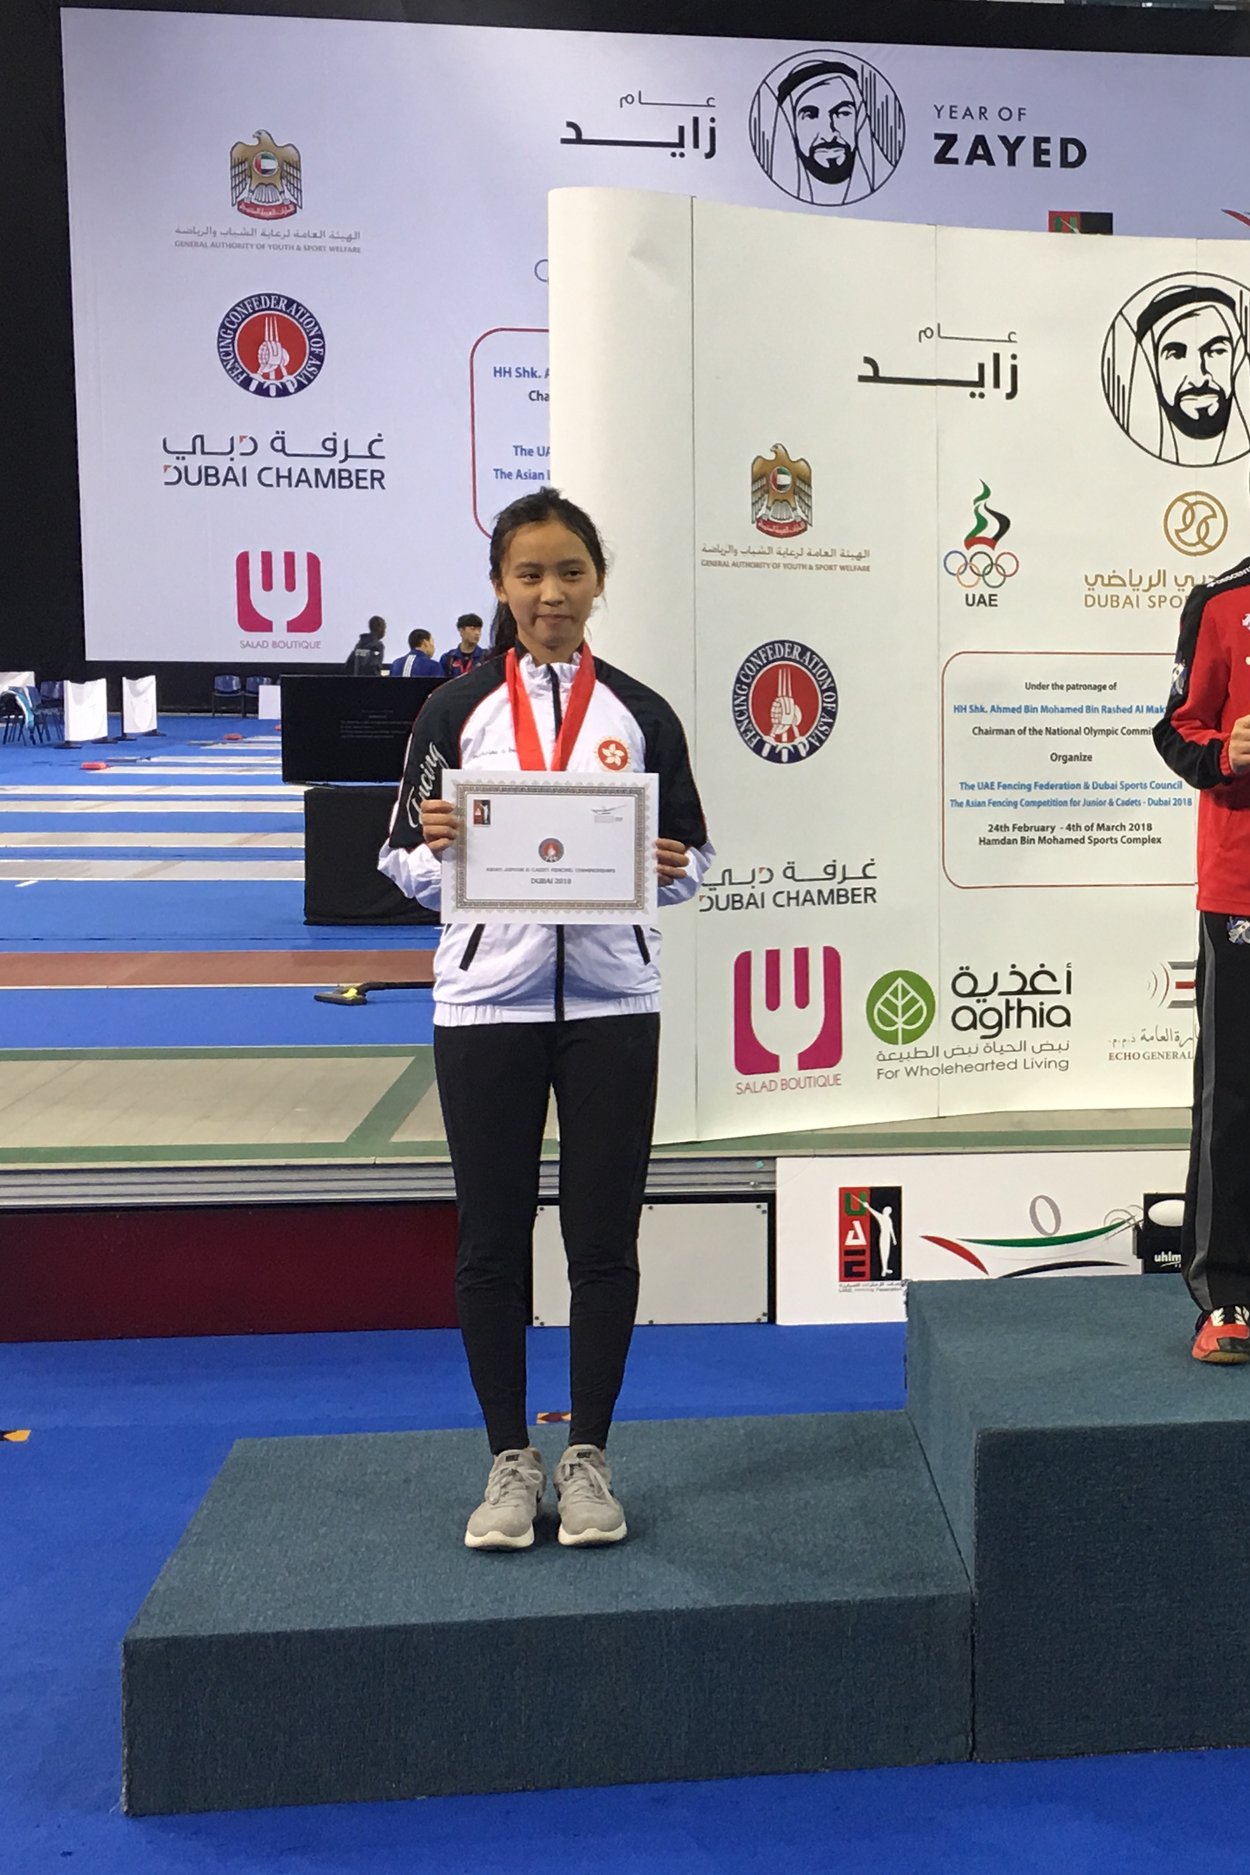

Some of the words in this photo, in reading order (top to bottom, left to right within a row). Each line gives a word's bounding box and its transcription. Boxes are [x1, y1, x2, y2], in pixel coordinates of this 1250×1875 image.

[620, 90, 717, 109] عام
[933, 104, 989, 121] YEAR
[998, 106, 1027, 122] OF
[560, 116, 717, 160] زايد
[933, 132, 1088, 169] ZAYED
[224, 295, 321, 337] CONFEDERATION
[918, 322, 1018, 343] عام
[219, 328, 248, 382] FENCING
[309, 338, 324, 356] OF
[296, 355, 321, 385] ASIA
[493, 366, 512, 378] HH
[515, 366, 542, 379] Shk.
[858, 352, 1018, 401] زايد
[162, 434, 258, 462] دبي
[270, 430, 386, 464] غرفة
[513, 445, 534, 457] The
[163, 464, 247, 487] DUBAI
[257, 466, 386, 490] CHAMBER
[493, 468, 513, 480] The
[516, 468, 545, 480] Asian
[772, 561, 781, 570] OF
[1084, 568, 1167, 593] الرياضي
[964, 593, 998, 608] UAE
[1084, 594, 1140, 609] DUBAI
[1147, 594, 1189, 609] SPO
[240, 640, 269, 649] SALAD
[271, 640, 321, 650] BOUTIQUE
[739, 642, 836, 690] CONFEDERATION
[1025, 682, 1050, 691] Under
[1051, 682, 1064, 691] the
[1066, 683, 1107, 692] patronage
[1109, 682, 1117, 691] of
[822, 691, 837, 712] OF
[953, 705, 967, 714] HH
[969, 705, 988, 714] Shk.
[990, 705, 1022, 714] Ahmed
[1023, 705, 1038, 714] Bin
[1040, 705, 1084, 714] Mohamed
[1085, 705, 1099, 714] Bin
[1101, 705, 1133, 714] Rashed
[1134, 705, 1144, 714] Al
[1146, 705, 1166, 714] Mak
[734, 683, 760, 748] FENCING
[808, 713, 834, 747] ASIA
[972, 726, 1016, 736] Chairman
[1017, 726, 1027, 736] of
[1028, 726, 1043, 736] the
[1044, 726, 1082, 736] National
[1083, 726, 1119, 738] Olympic
[1120, 726, 1153, 736] Commi
[1050, 752, 1093, 764] Organize
[959, 781, 975, 791] The
[977, 781, 995, 791] UAE
[997, 781, 1032, 792] Fencing
[1033, 781, 1081, 791] Federation
[1083, 782, 1090, 790] &
[1091, 781, 1118, 790] Dubai
[1119, 781, 1148, 791] Sports
[1149, 781, 1183, 790] Council
[950, 799, 964, 808] The
[965, 799, 986, 808] Asian
[987, 799, 1018, 809] Fencing
[1019, 799, 1068, 809] Competition
[1069, 798, 1081, 807] for
[1081, 798, 1107, 808] Junior
[1108, 798, 1114, 807] &
[1115, 798, 1141, 807] Cadets
[1147, 798, 1171, 807] Dubai
[1172, 798, 1193, 807] 2018
[987, 823, 1010, 833] 24th
[1012, 823, 1056, 834] February
[1065, 823, 1083, 832] 4th
[1084, 823, 1095, 832] of
[1096, 823, 1126, 832] March
[1128, 822, 1153, 832] 2018
[978, 836, 1018, 846] Hamdan
[1020, 836, 1036, 845] Bin
[1037, 836, 1085, 845] Mohamed
[1087, 836, 1118, 847] Sports
[1120, 835, 1162, 846] Complex
[783, 858, 877, 884] غرفة
[699, 892, 765, 913] DUBAI
[772, 887, 877, 908] CHAMBER
[951, 962, 1072, 1004] أغذية
[951, 998, 1071, 1039] agthia
[876, 1045, 939, 1063] الطبيعة
[943, 1044, 979, 1059] نبض
[983, 1040, 1026, 1055] الحياة
[1031, 1040, 1070, 1054] نبض
[1108, 1051, 1141, 1061] ECHO
[1142, 1051, 1194, 1060] GENERAL
[876, 1067, 900, 1080] For
[904, 1058, 1018, 1078] Wholehearted
[1023, 1057, 1069, 1072] Living
[736, 1080, 778, 1095] SALAD
[780, 1073, 842, 1091] BOUTIQUE
